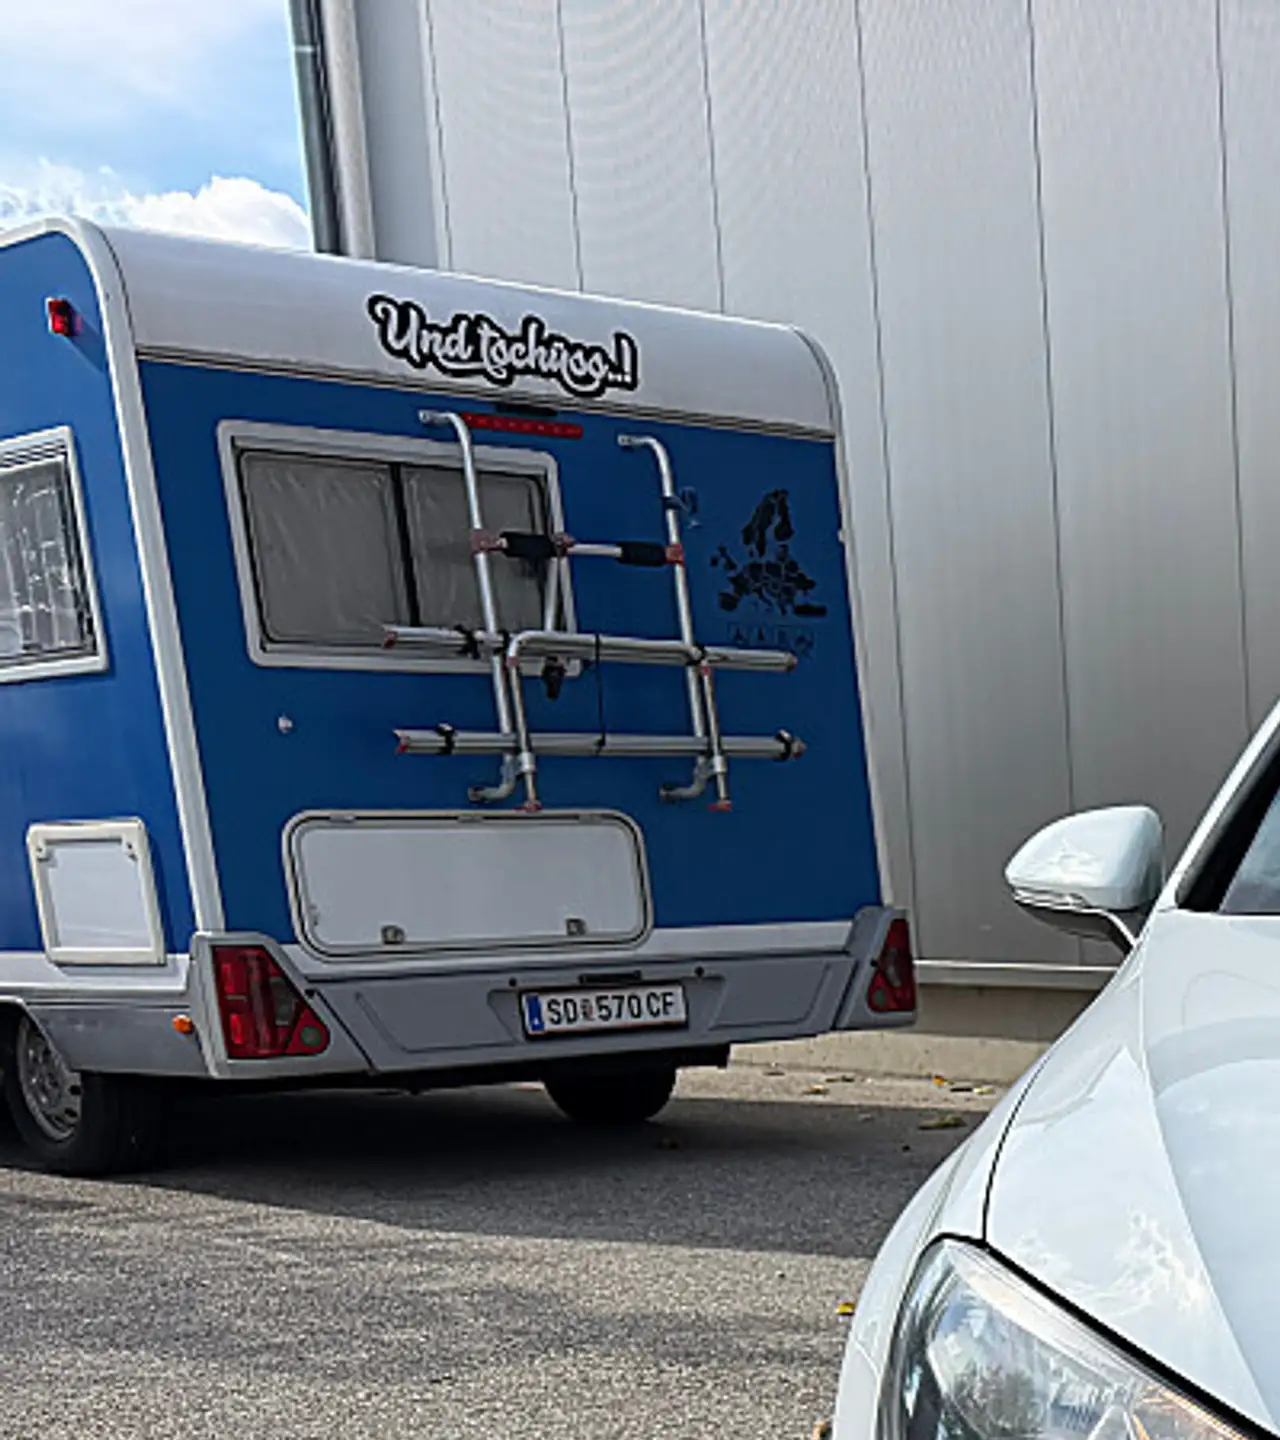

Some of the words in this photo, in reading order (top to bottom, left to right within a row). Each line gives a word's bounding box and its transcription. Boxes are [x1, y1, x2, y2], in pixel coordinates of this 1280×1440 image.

[371, 299, 474, 366] Und
[548, 998, 577, 1025] SD
[596, 993, 642, 1021] 570
[647, 991, 675, 1018] CF
